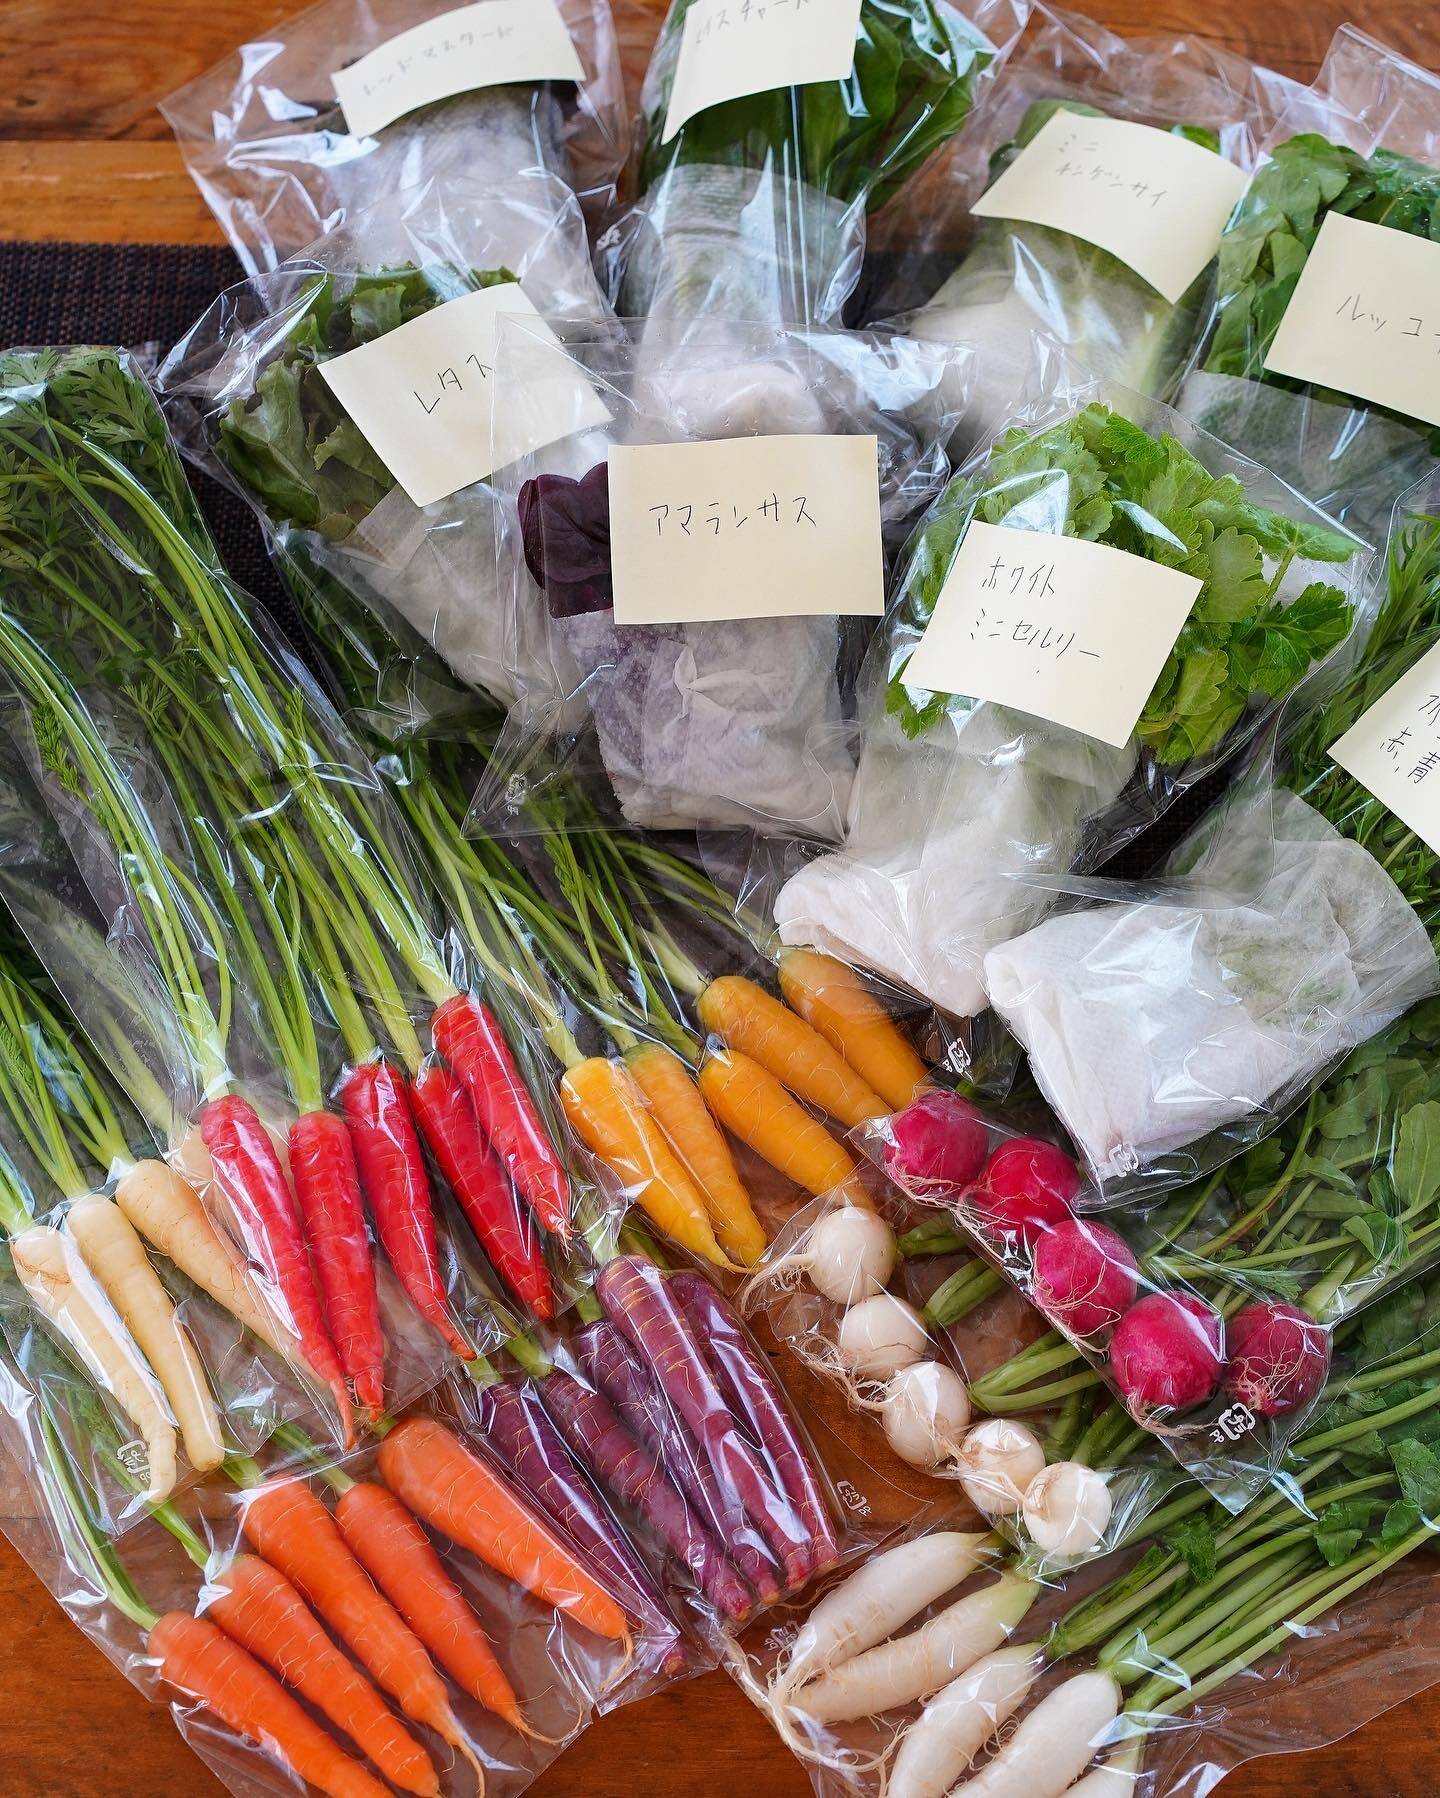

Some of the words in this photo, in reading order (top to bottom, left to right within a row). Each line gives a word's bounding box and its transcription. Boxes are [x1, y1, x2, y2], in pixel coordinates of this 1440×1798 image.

[1057, 133, 1099, 153] ミニ
[1335, 293, 1440, 342] ルッコ
[413, 353, 494, 414] レタス
[649, 492, 817, 536] アマランサス
[981, 556, 1055, 598] ホワイト
[970, 607, 1101, 658] ミニセルリー
[1208, 1428, 1225, 1443] PP
